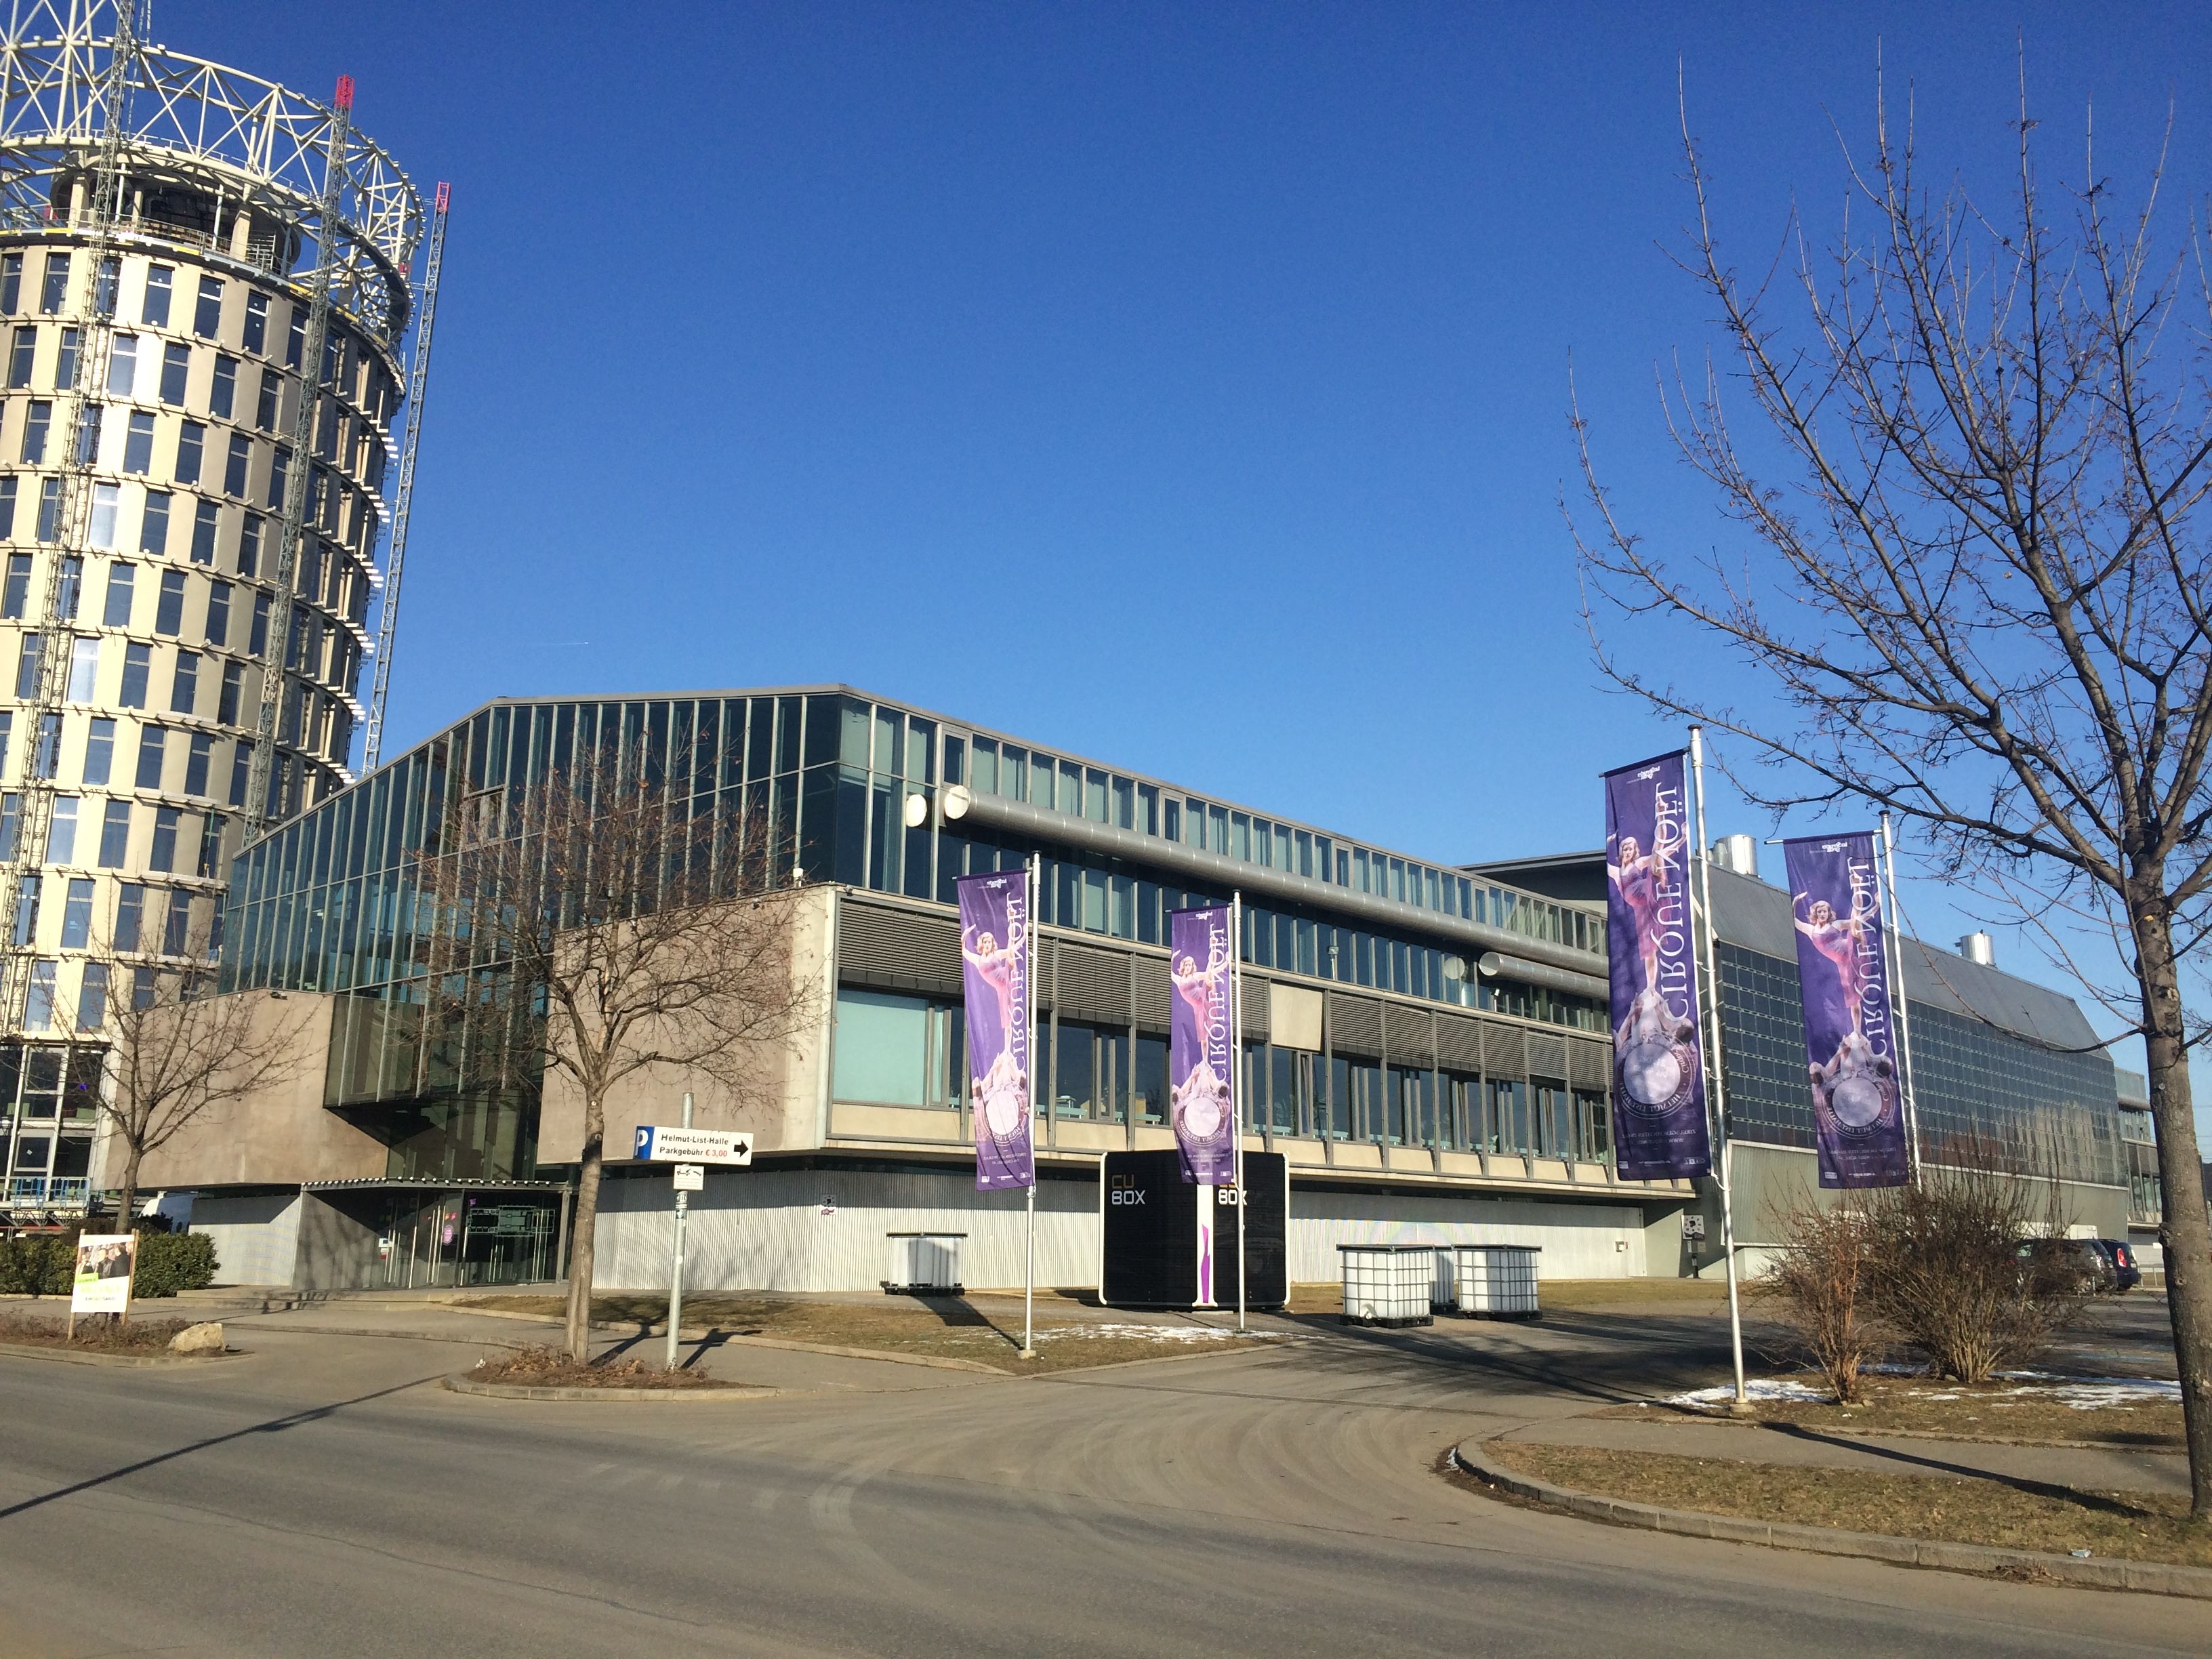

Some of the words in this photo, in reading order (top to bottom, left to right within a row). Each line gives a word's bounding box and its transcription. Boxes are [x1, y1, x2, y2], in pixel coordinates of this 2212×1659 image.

[634, 1129, 649, 1155] P
[661, 1134, 729, 1145] Helmut-List-Halle
[659, 1146, 703, 1156] Parkgebühr
[712, 1149, 728, 1158] 3,00
[1111, 1174, 1134, 1189] CU
[1111, 1189, 1146, 1205] BOX
